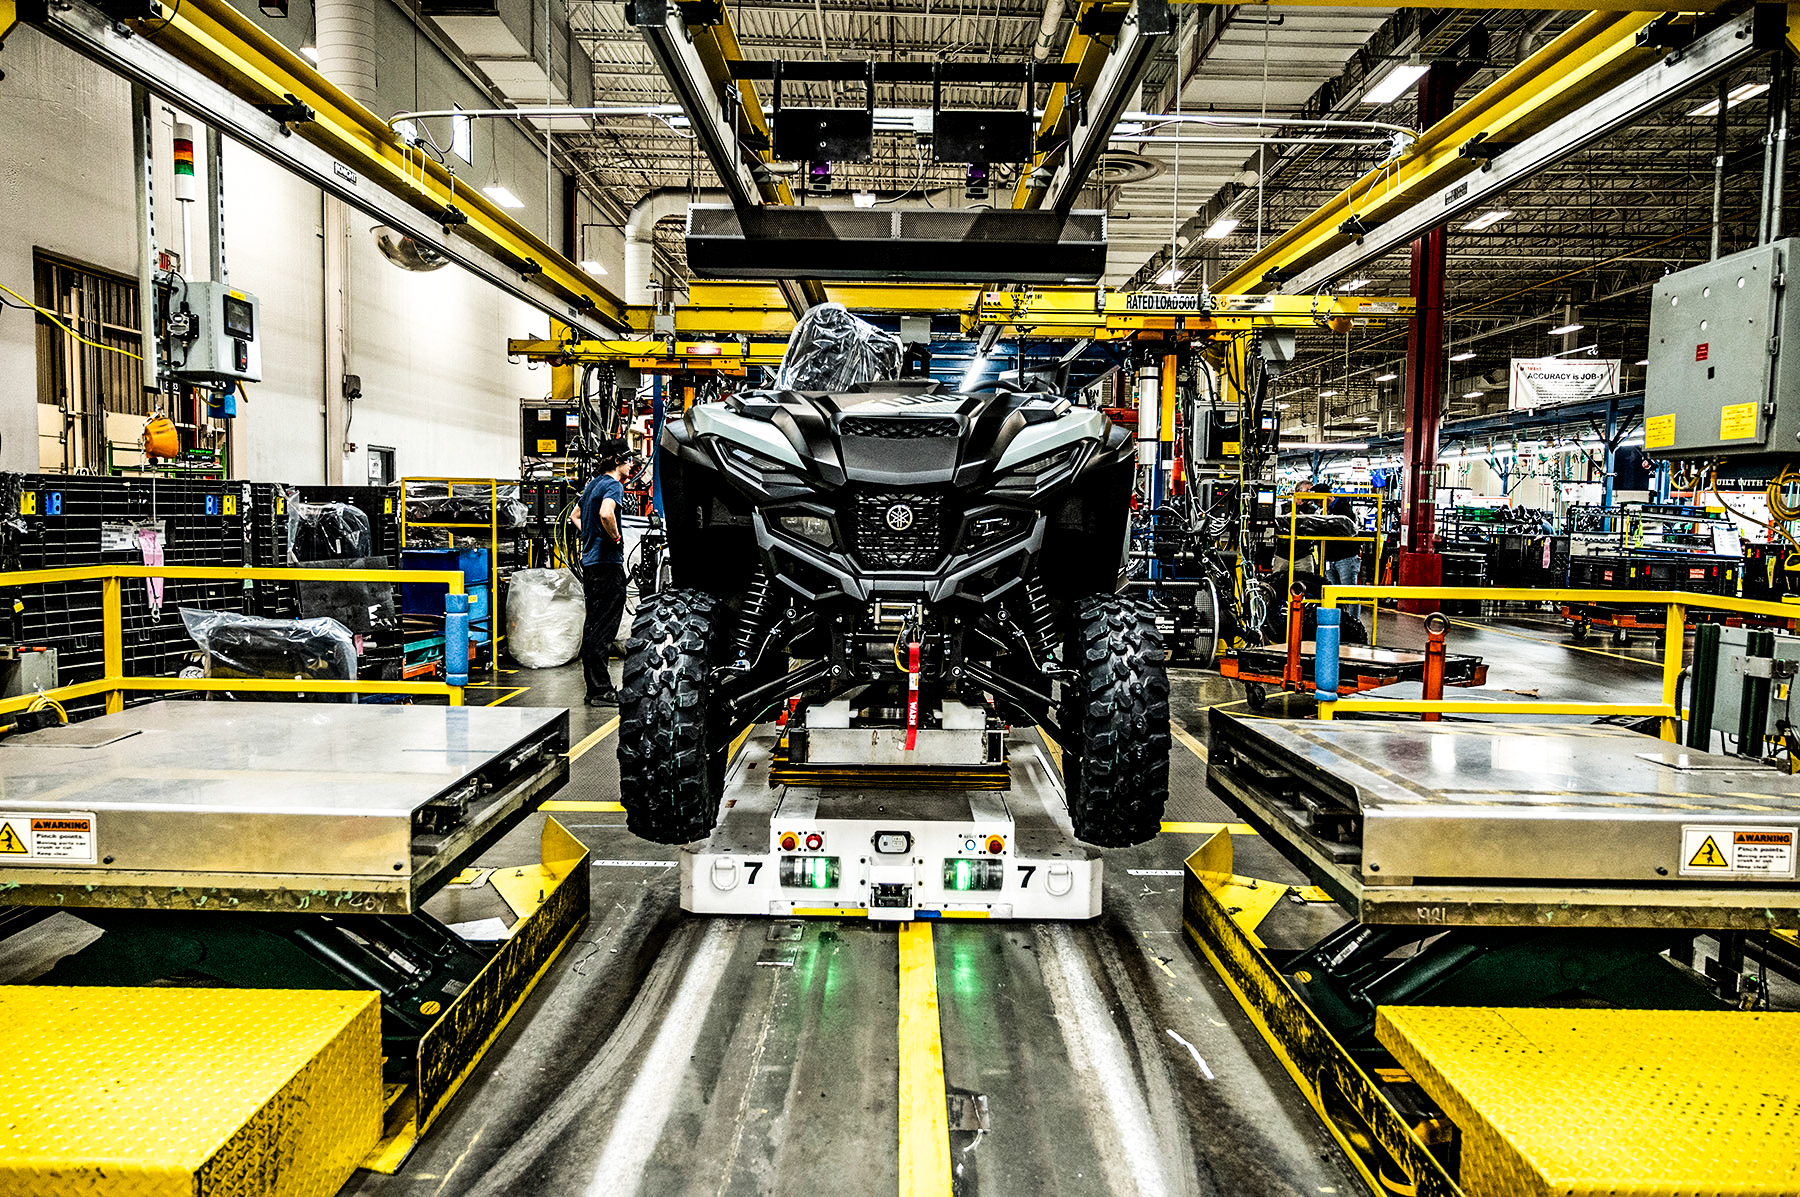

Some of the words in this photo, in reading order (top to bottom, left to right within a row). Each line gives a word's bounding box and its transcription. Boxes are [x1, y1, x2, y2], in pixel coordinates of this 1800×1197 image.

[1126, 295, 1153, 310] RATED
[1155, 295, 1178, 310] LOAD
[1179, 295, 1196, 310] 500
[1738, 479, 1765, 487] WITH
[908, 702, 917, 726] WARN
[42, 821, 88, 830] WARNING
[1746, 834, 1790, 843] WARNING
[743, 861, 763, 885] 7
[1017, 866, 1037, 889] 7
